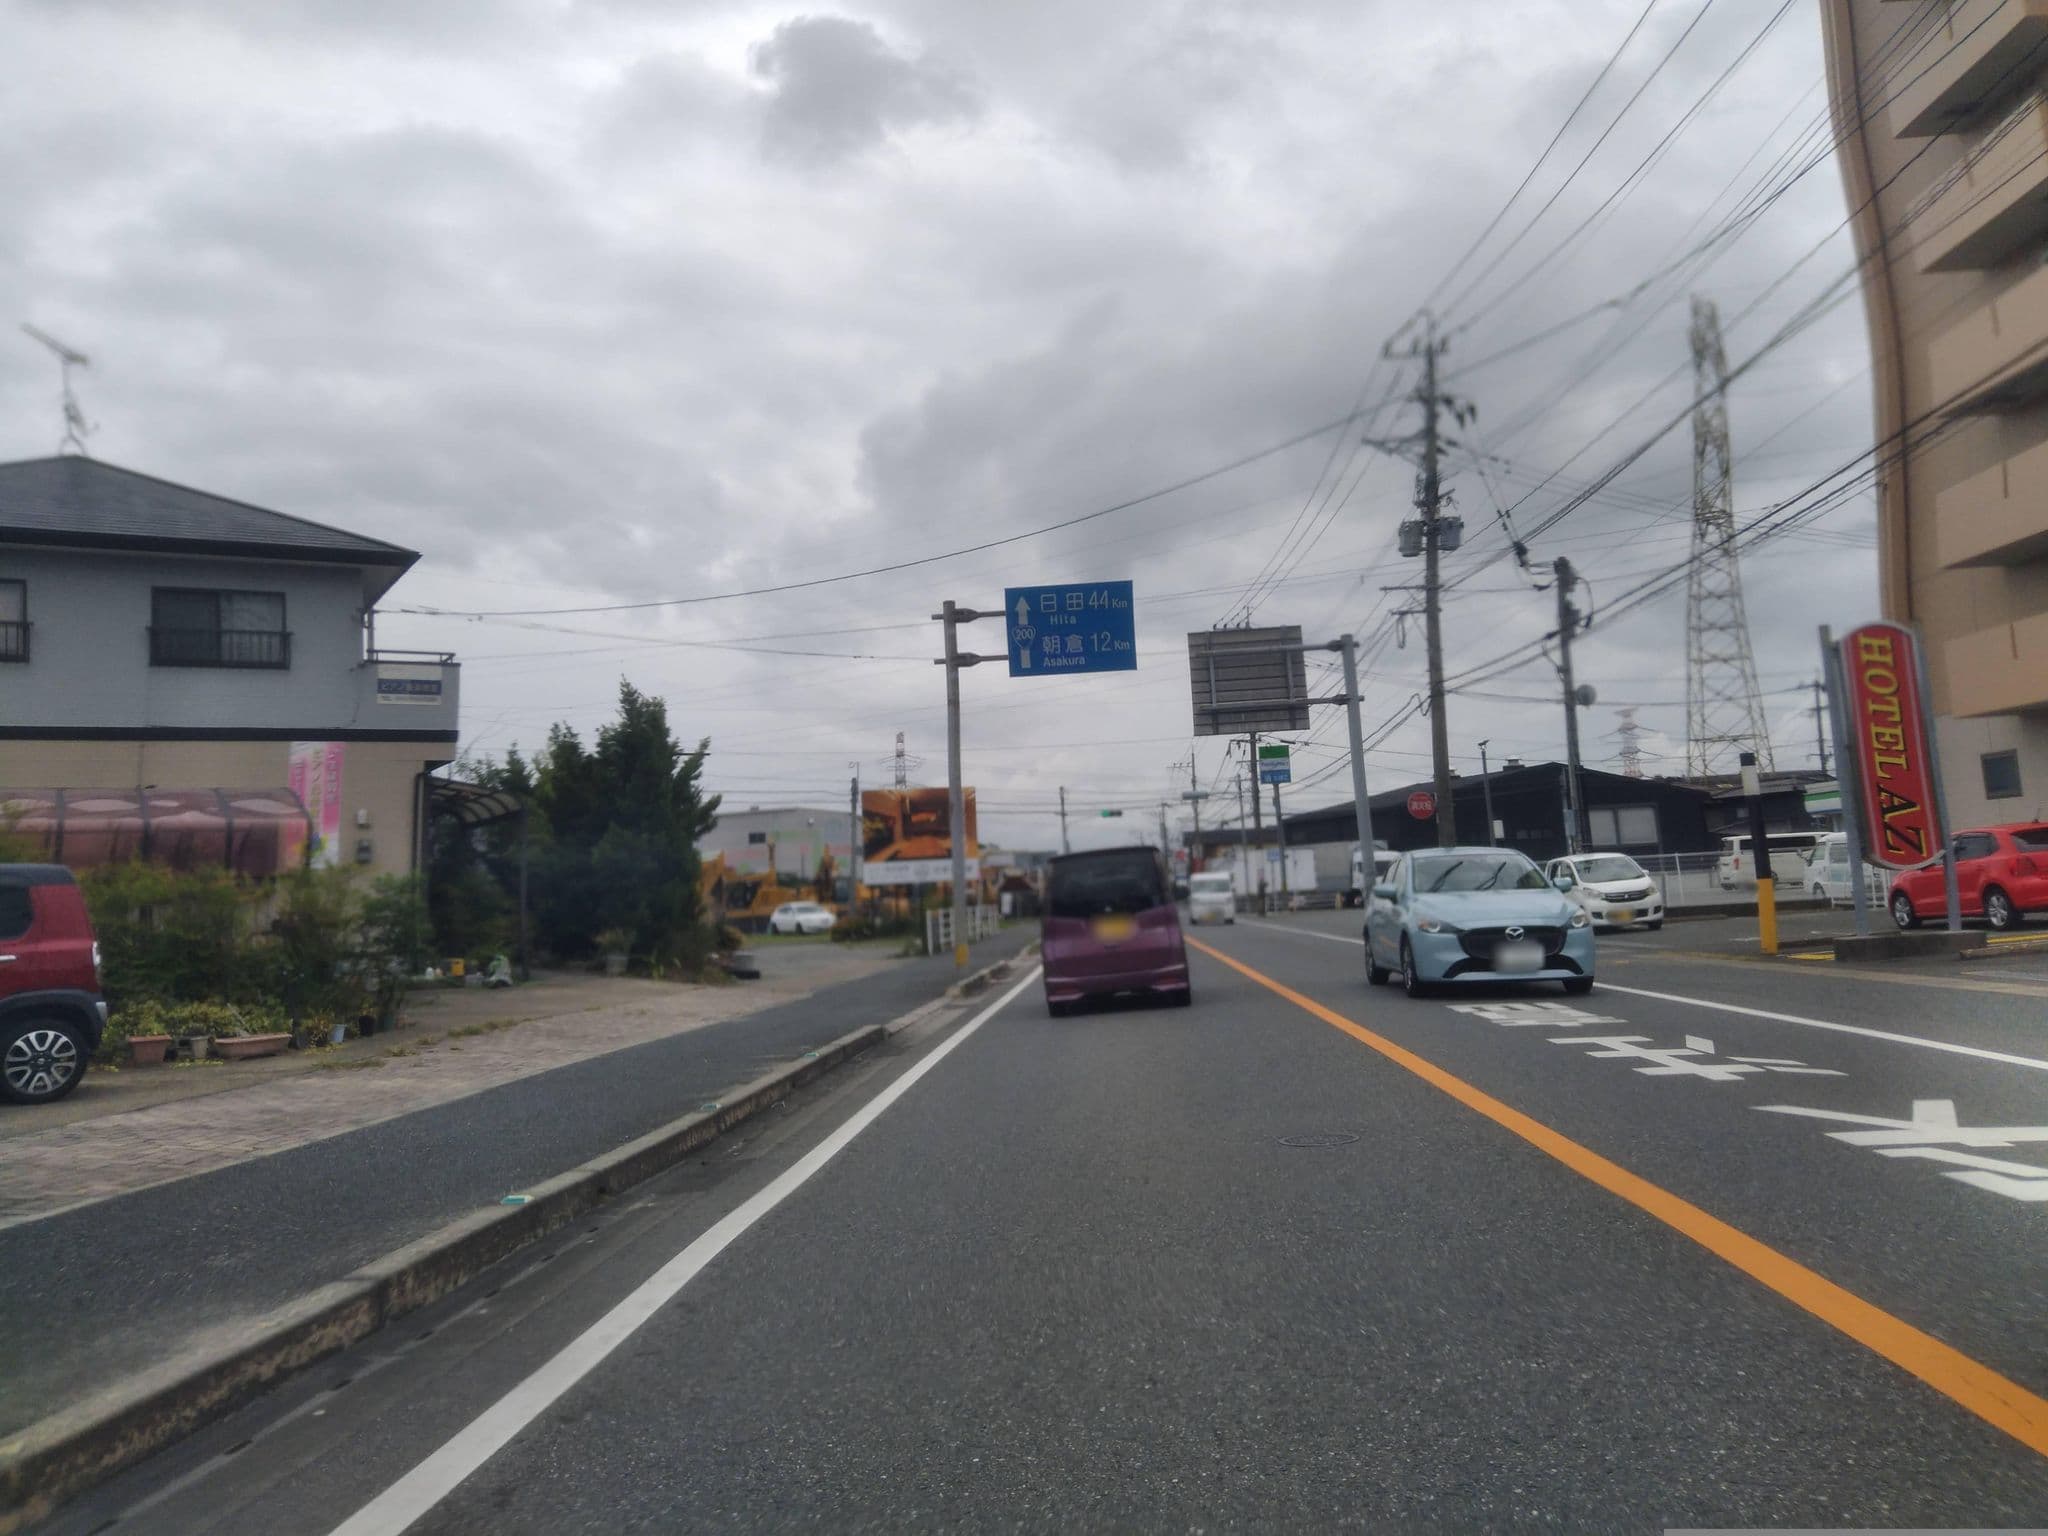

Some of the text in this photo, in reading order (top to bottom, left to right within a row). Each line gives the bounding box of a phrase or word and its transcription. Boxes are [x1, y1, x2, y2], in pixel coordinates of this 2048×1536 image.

[1041, 592, 1084, 612] 日田
[1089, 590, 1109, 609] 44
[1050, 614, 1077, 625] Hita
[1090, 631, 1112, 653] 12
[1043, 655, 1086, 668] Asakura
[1859, 633, 1927, 857] HOTEL AZ
